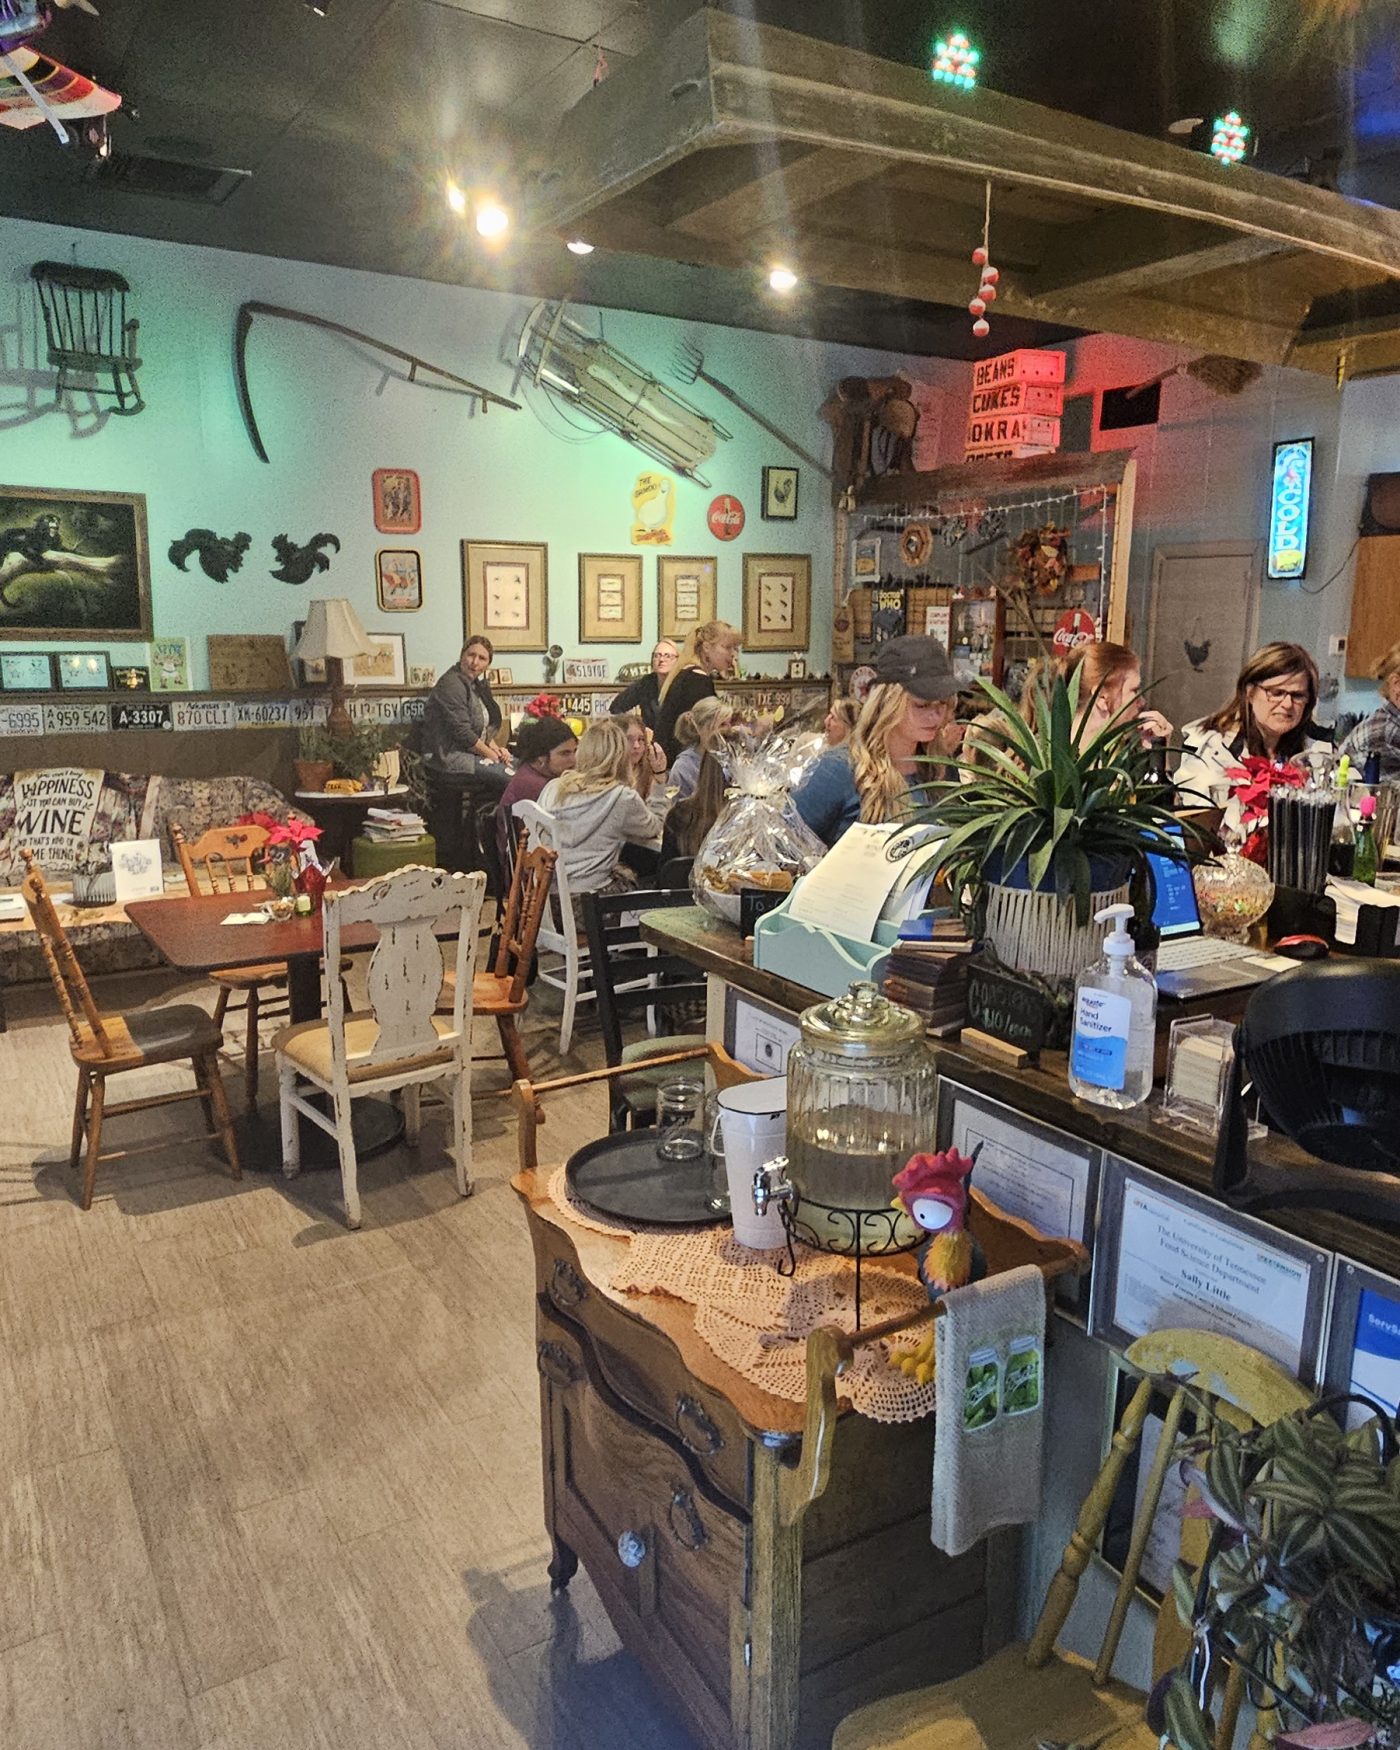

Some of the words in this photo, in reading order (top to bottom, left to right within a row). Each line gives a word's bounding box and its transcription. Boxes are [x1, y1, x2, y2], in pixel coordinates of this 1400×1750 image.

[976, 357, 1015, 386] BEANS
[972, 385, 1021, 414] CUKES
[971, 419, 1020, 443] OKRA
[879, 599, 901, 610] WHO
[56, 710, 79, 727] 959
[82, 709, 106, 727] 542
[177, 710, 202, 726] 870
[17, 808, 86, 836] WINE
[1080, 1008, 1099, 1021] Hand
[1080, 1016, 1113, 1033] Sanitizer
[1158, 1225, 1171, 1239] The
[1172, 1232, 1213, 1260] University
[1213, 1253, 1224, 1263] of
[1225, 1256, 1267, 1285] Tennessee
[1159, 1237, 1180, 1254] Food
[1180, 1248, 1210, 1270] Science
[1211, 1263, 1261, 1295] Department
[1180, 1269, 1203, 1291] Sally
[1206, 1281, 1233, 1302] Little
